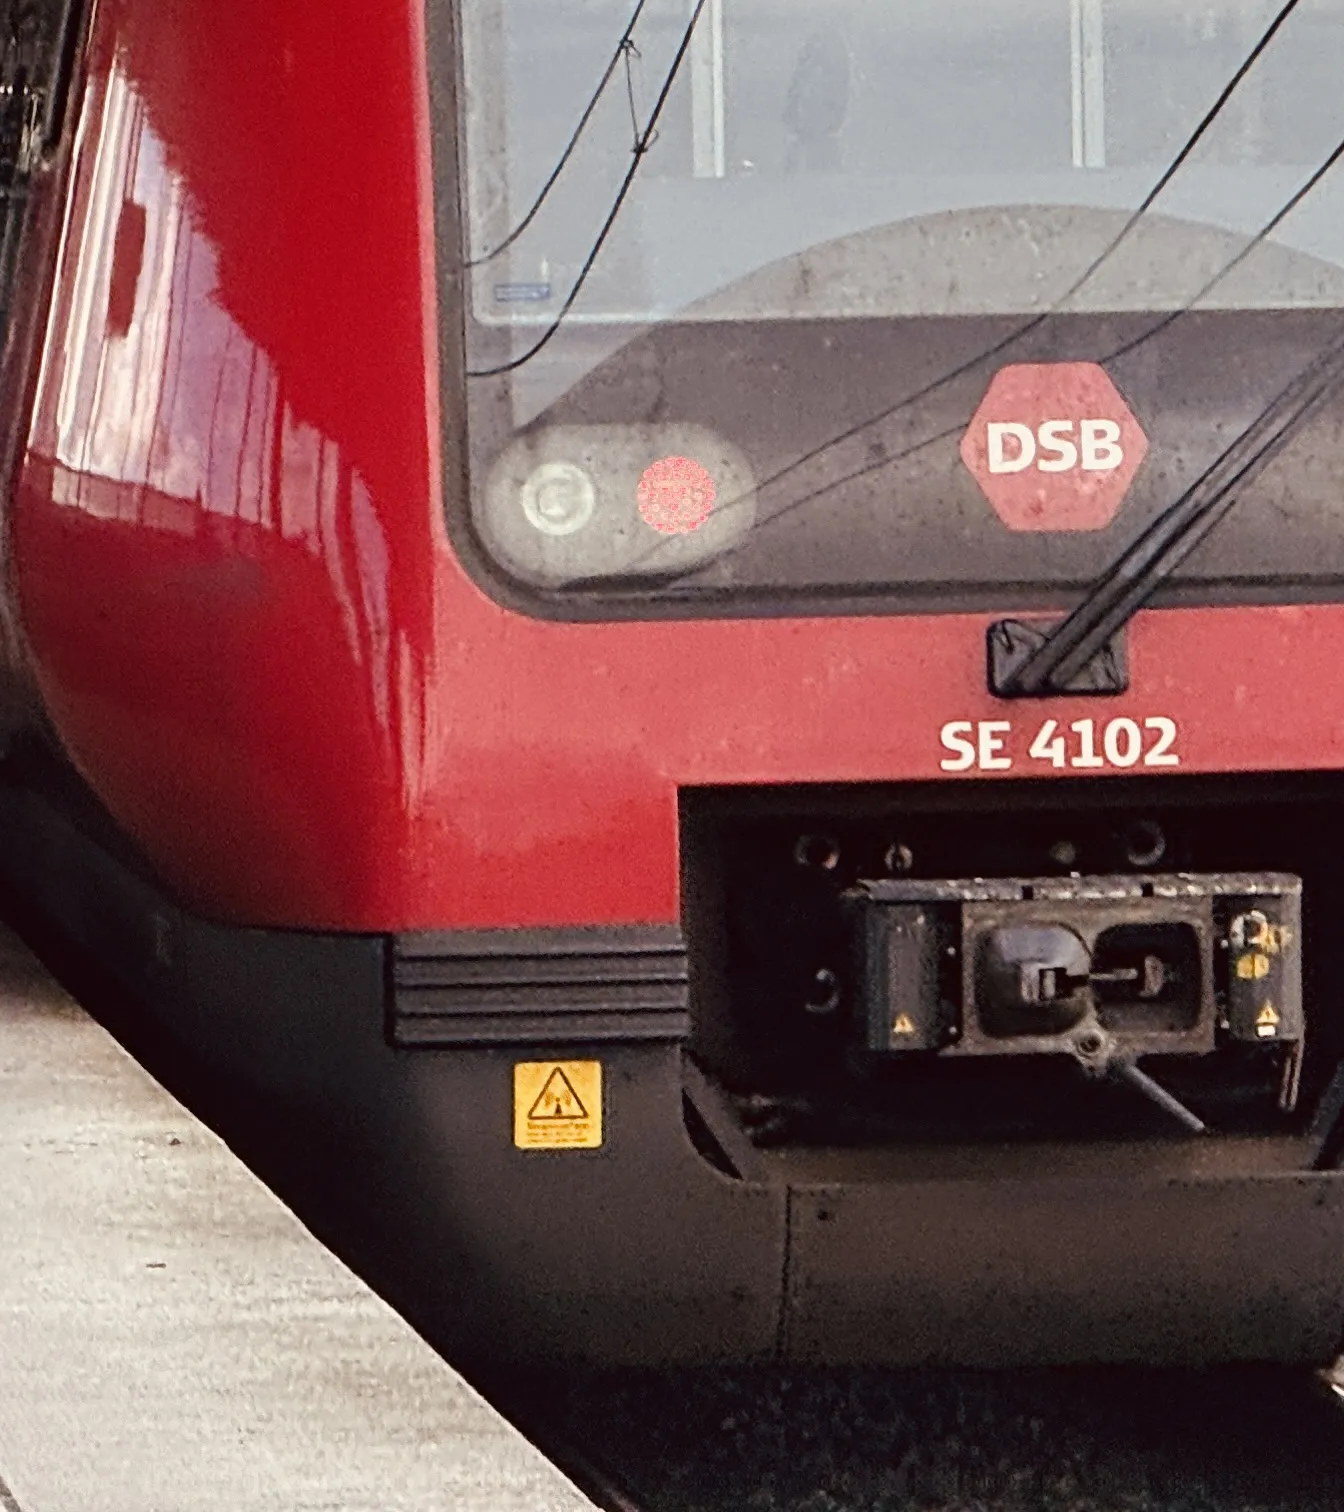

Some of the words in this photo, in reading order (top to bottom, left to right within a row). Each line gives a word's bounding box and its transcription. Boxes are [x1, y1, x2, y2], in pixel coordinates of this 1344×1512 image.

[987, 419, 1124, 473] DSB
[940, 721, 1012, 771] SE
[1029, 717, 1179, 769] 4102
